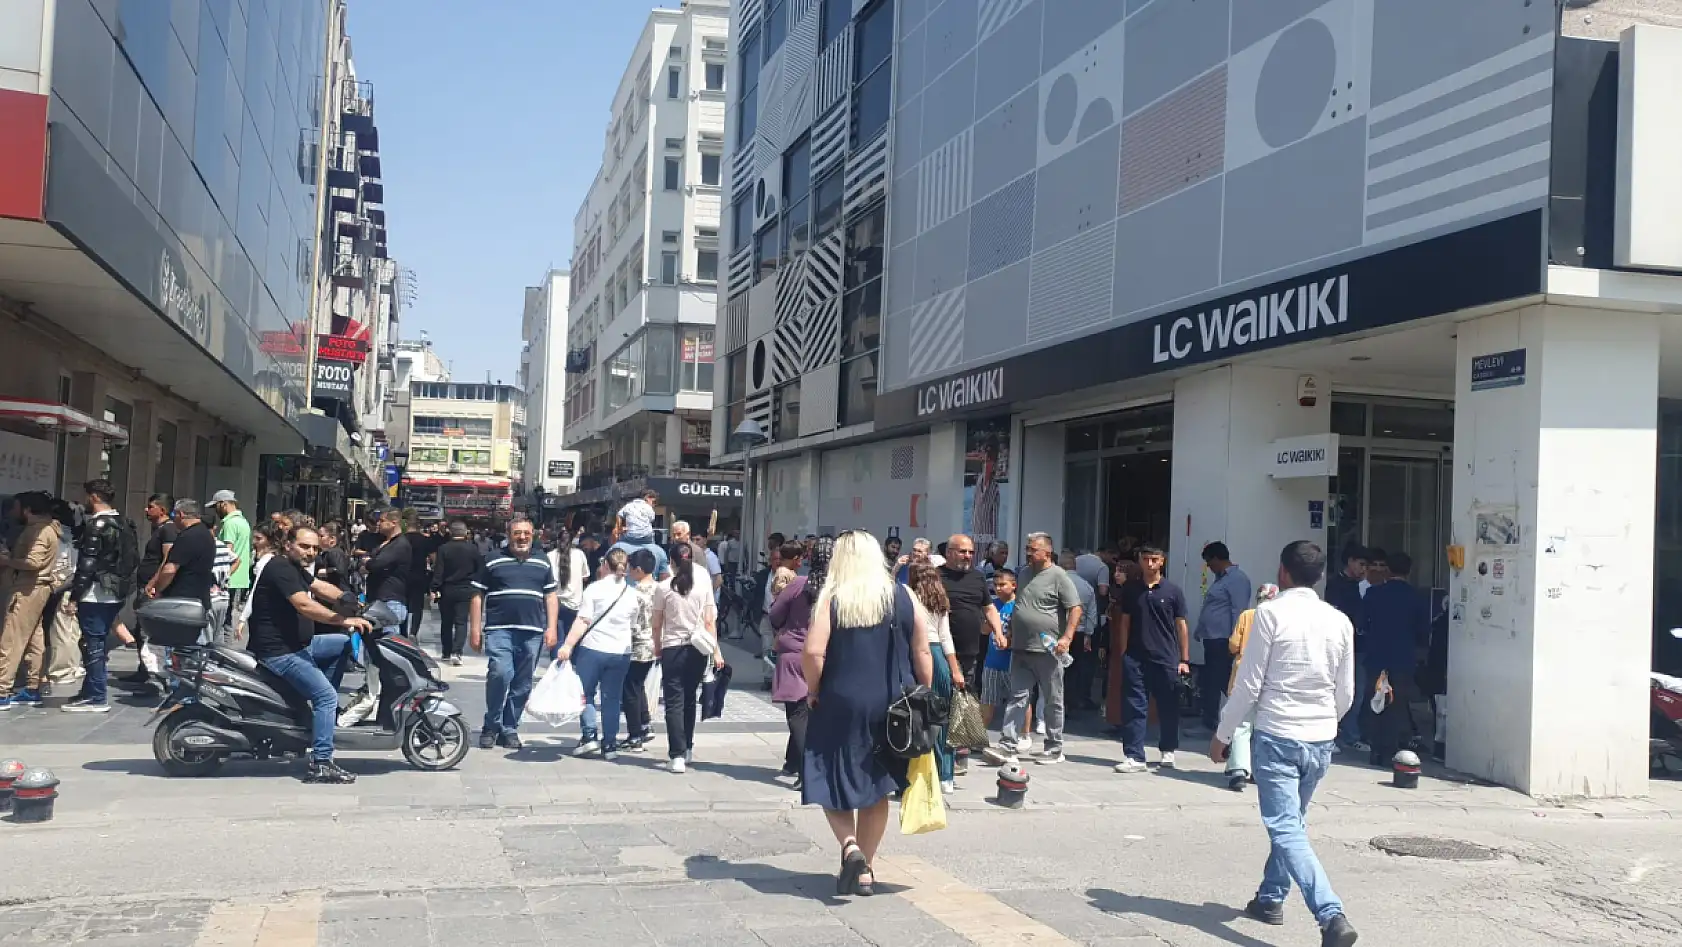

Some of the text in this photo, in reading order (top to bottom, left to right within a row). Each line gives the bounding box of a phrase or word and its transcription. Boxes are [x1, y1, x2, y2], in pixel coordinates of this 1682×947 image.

[1152, 316, 1193, 364] LC
[317, 364, 351, 382] FOTO
[316, 381, 349, 391] MUSTAFA
[917, 385, 937, 416] LC
[1276, 451, 1289, 465] LC
[678, 481, 731, 497] GÜLER
